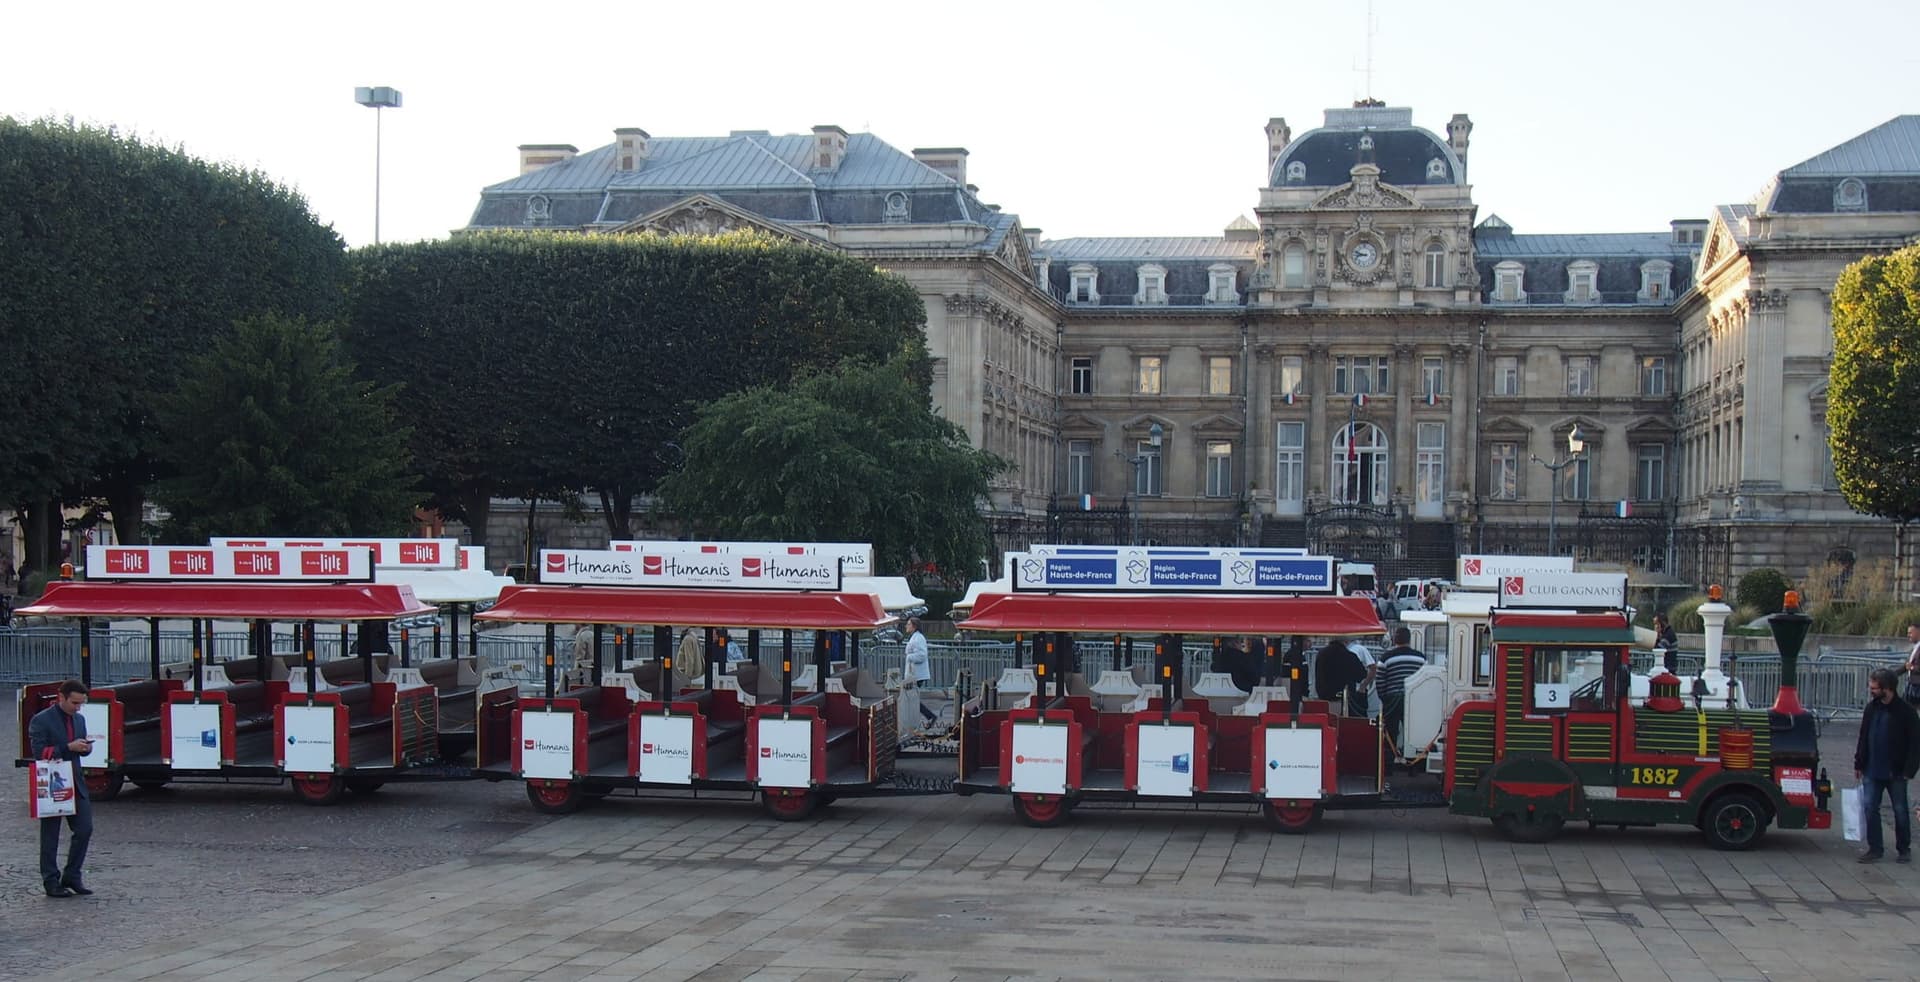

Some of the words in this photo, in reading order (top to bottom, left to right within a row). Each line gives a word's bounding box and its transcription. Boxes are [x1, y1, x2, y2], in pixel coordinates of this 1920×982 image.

[568, 554, 632, 575] Humanis
[665, 556, 730, 577] Humanis
[764, 558, 831, 580] Humanis
[1050, 571, 1113, 579] Hauts-de-France
[1154, 572, 1217, 580] Hauts-de-France
[1259, 573, 1324, 581] Hauts-de-France
[1529, 585, 1557, 595] CLUB
[1560, 586, 1622, 597] GAGNANTS
[1548, 690, 1557, 702] 3
[535, 739, 570, 752] Humanis
[654, 743, 689, 756] Humanis
[772, 747, 807, 760] Humanis
[1631, 767, 1680, 785] 1887
